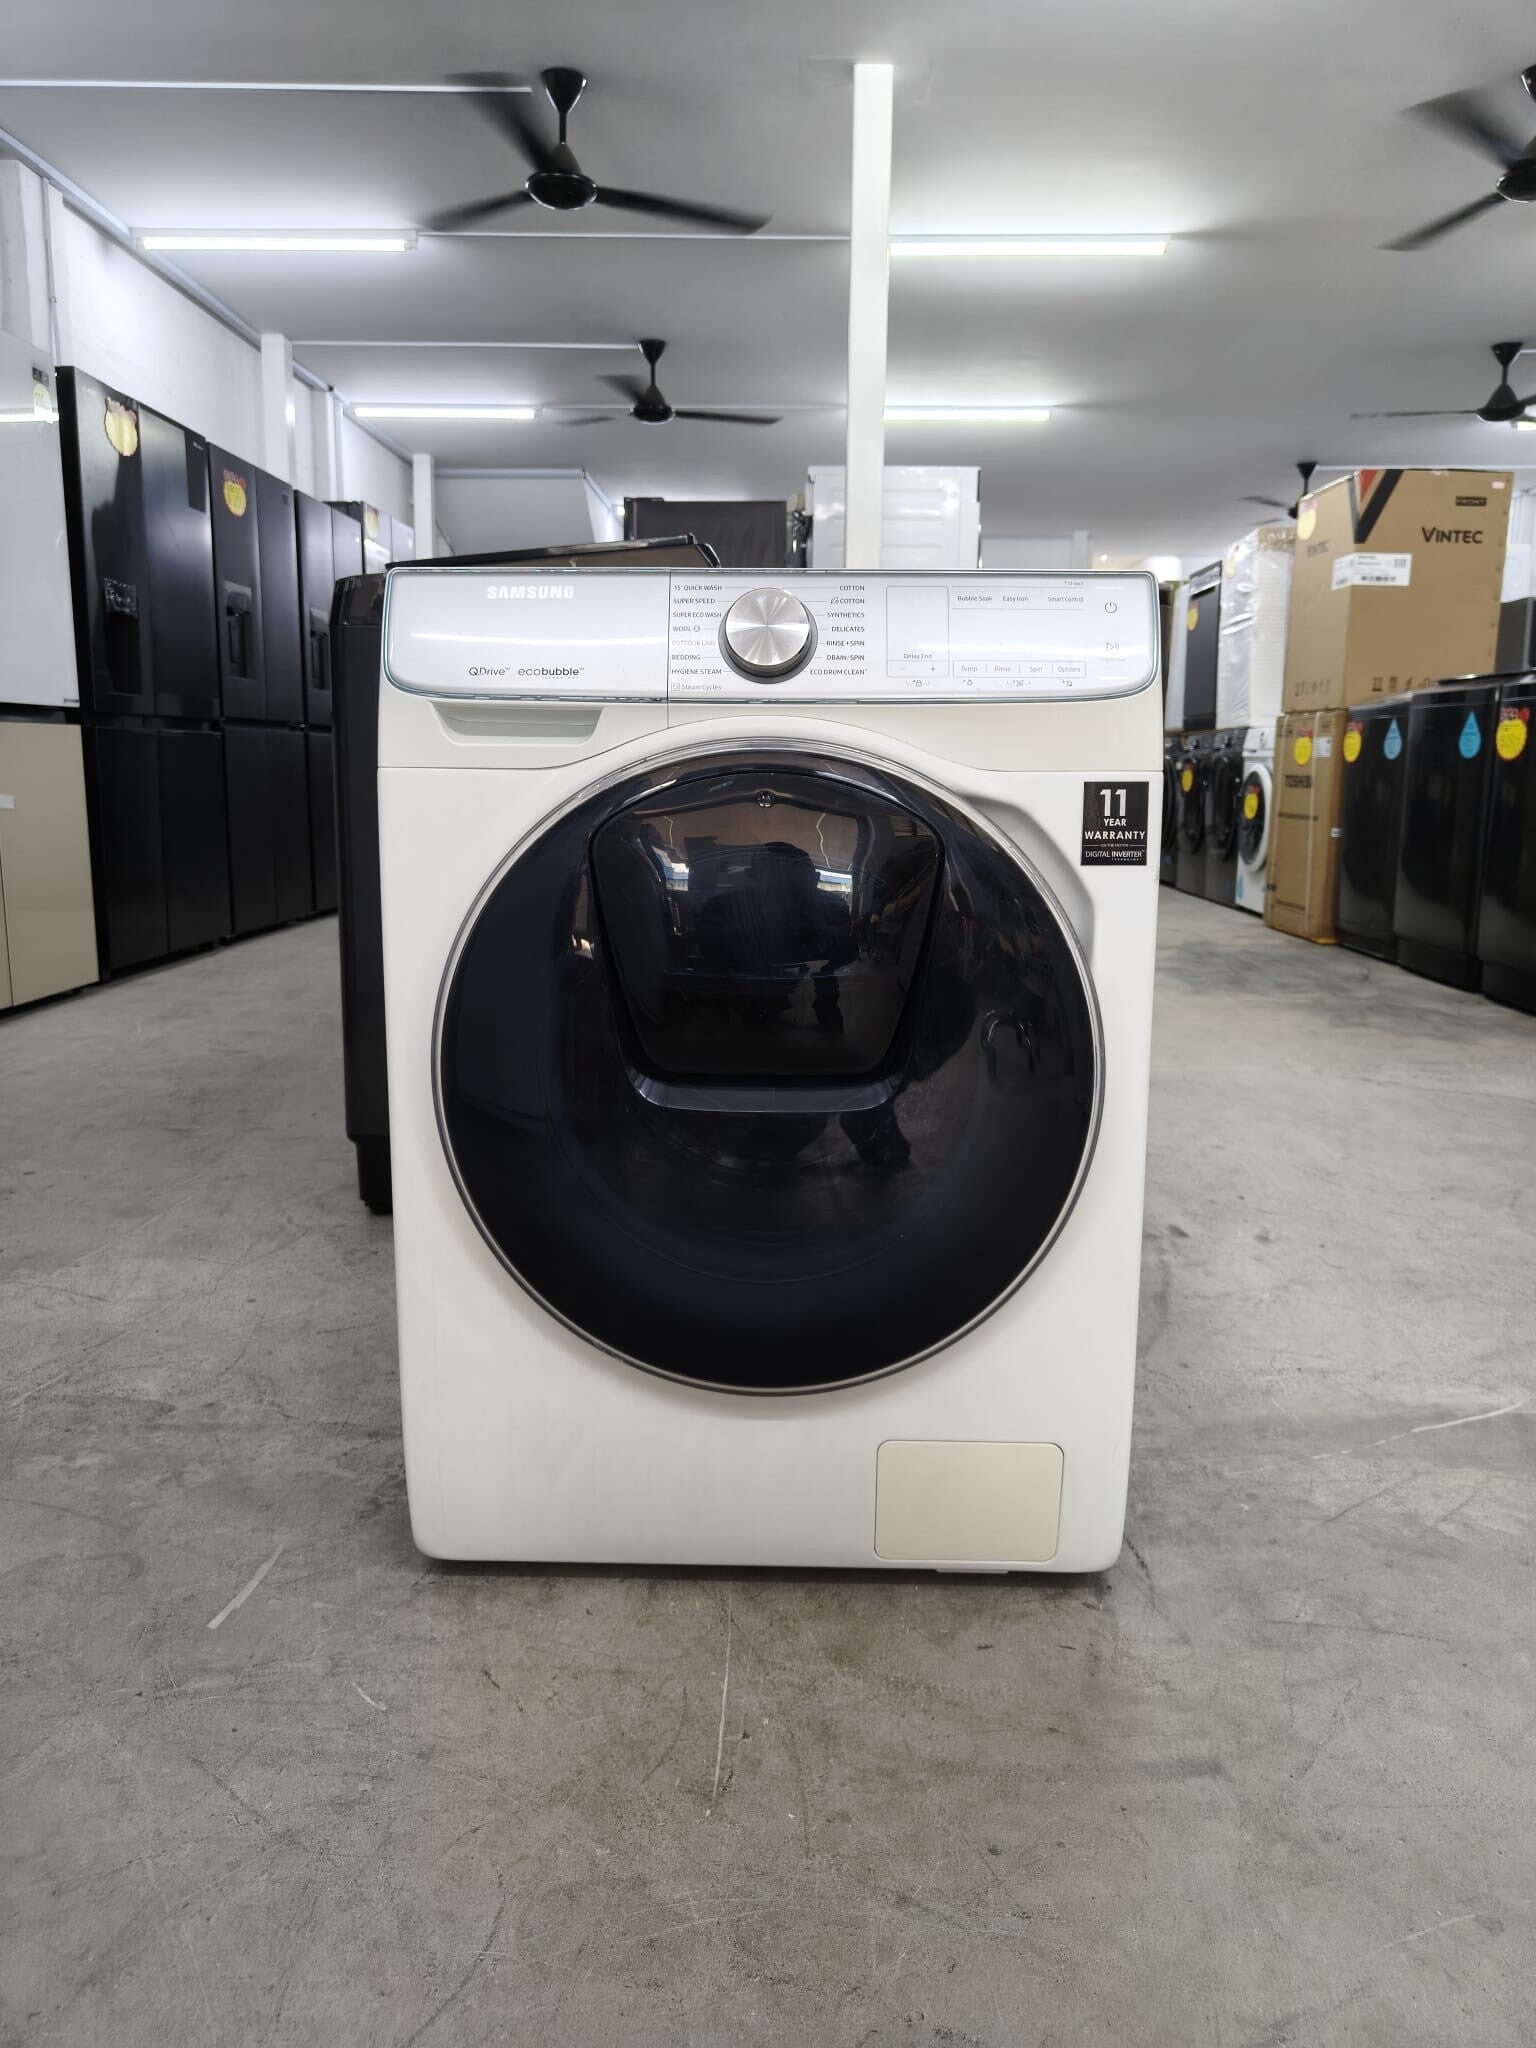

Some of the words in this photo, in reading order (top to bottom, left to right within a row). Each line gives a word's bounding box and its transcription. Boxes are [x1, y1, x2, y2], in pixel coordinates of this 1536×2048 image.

[487, 585, 575, 599] SAMSUNG
[903, 652, 920, 660] Delay
[920, 652, 933, 660] End
[960, 665, 977, 673] Temp
[1029, 665, 1043, 673] Spin
[1057, 665, 1081, 673] Options
[1100, 789, 1127, 817] 11
[1104, 818, 1127, 827] YEAR
[1084, 831, 1146, 840] WARRANTY
